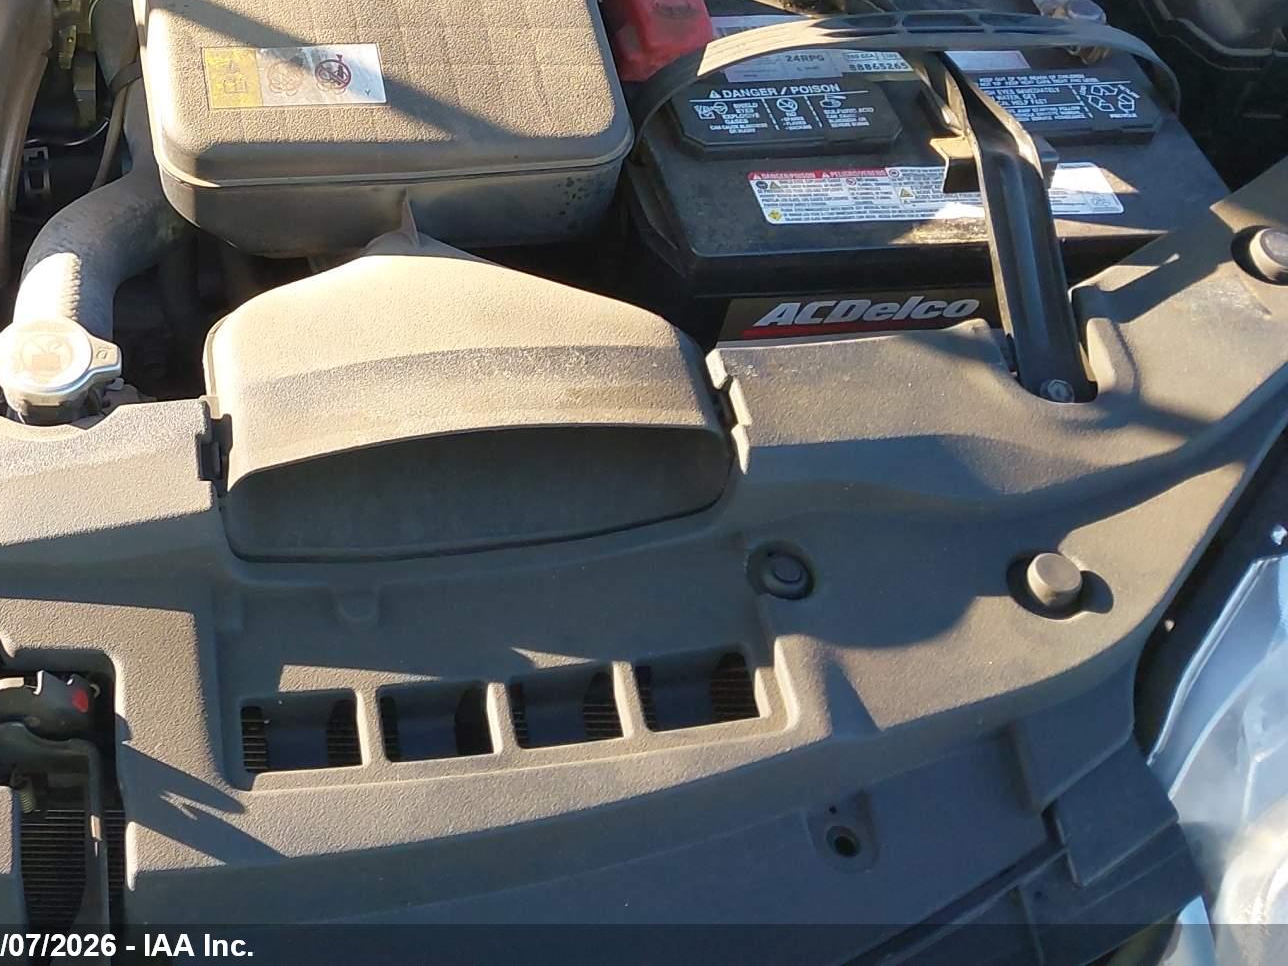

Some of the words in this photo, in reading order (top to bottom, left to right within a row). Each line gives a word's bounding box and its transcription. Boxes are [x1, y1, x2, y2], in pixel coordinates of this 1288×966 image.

[722, 87, 777, 99] DANGER
[790, 84, 841, 95] POISON
[752, 295, 981, 327] ACDelco
